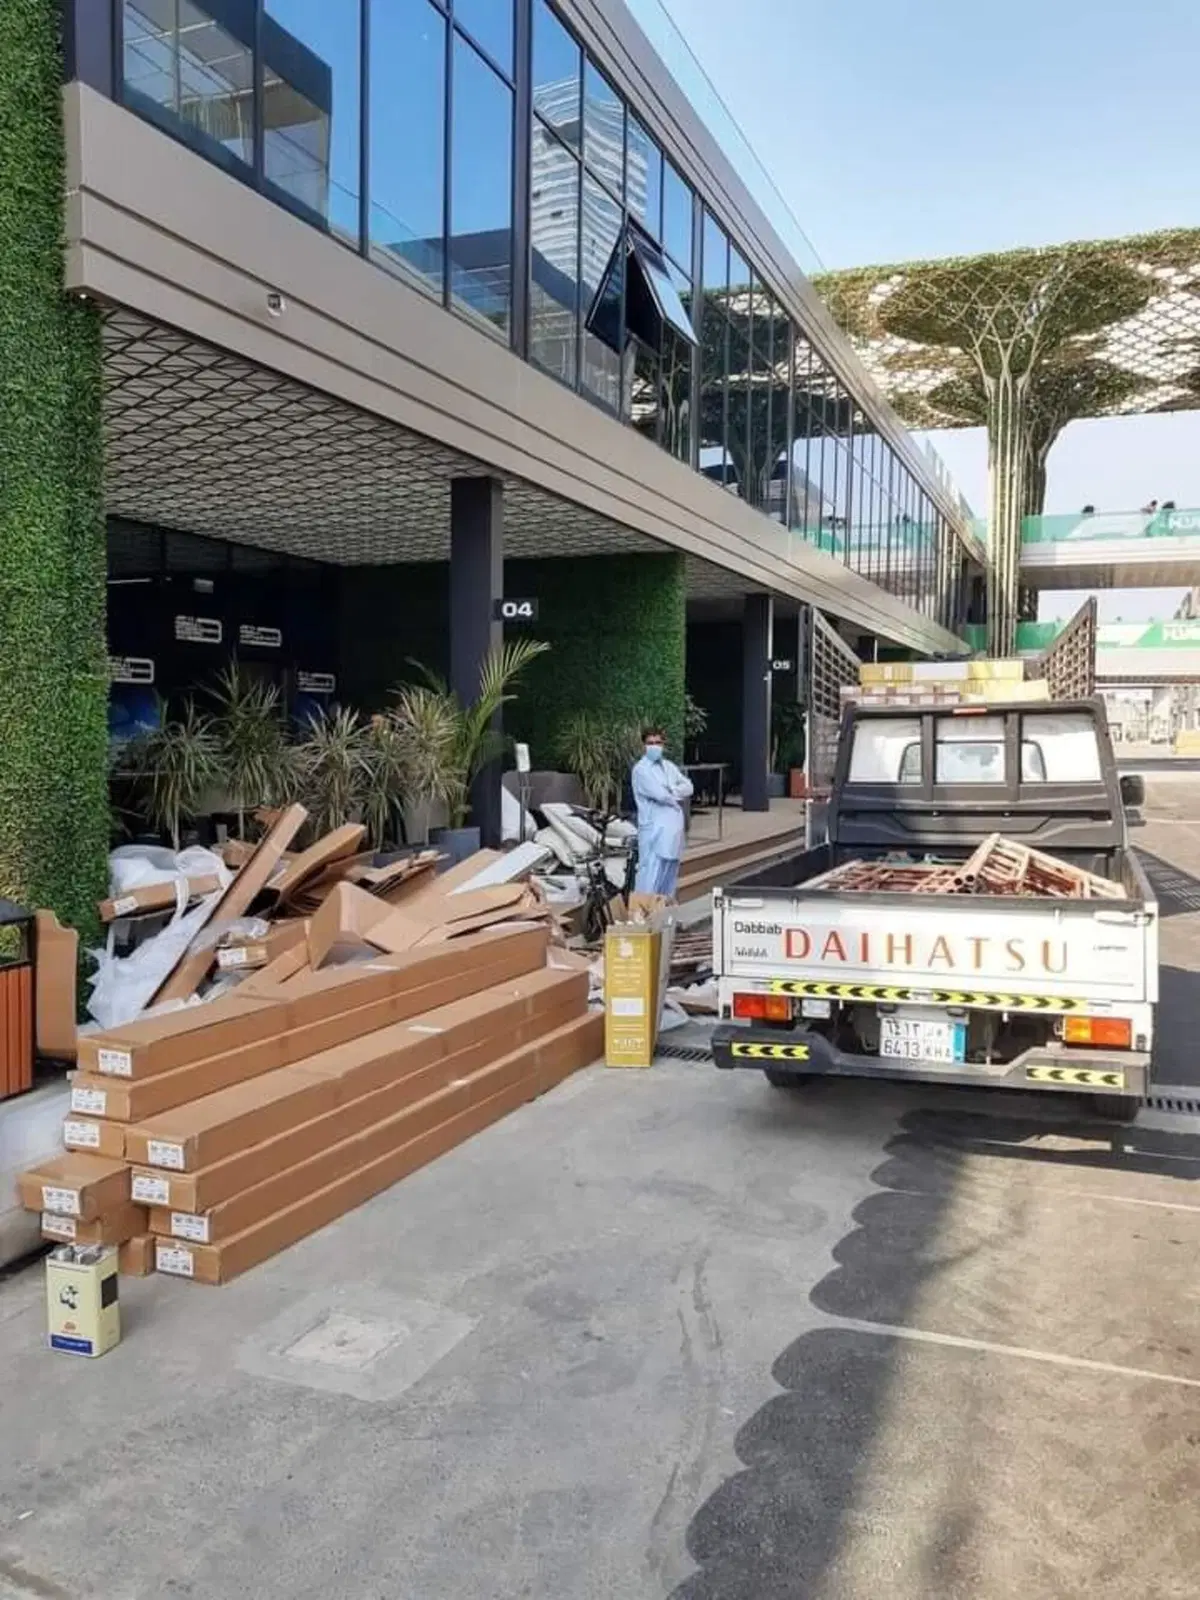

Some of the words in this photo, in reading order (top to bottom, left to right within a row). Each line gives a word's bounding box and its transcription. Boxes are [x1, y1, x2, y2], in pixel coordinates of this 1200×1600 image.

[502, 602, 533, 617] 04
[734, 921, 782, 935] Dabbab
[785, 927, 1067, 973] DAIHATSU
[884, 1039, 920, 1057] 6413
